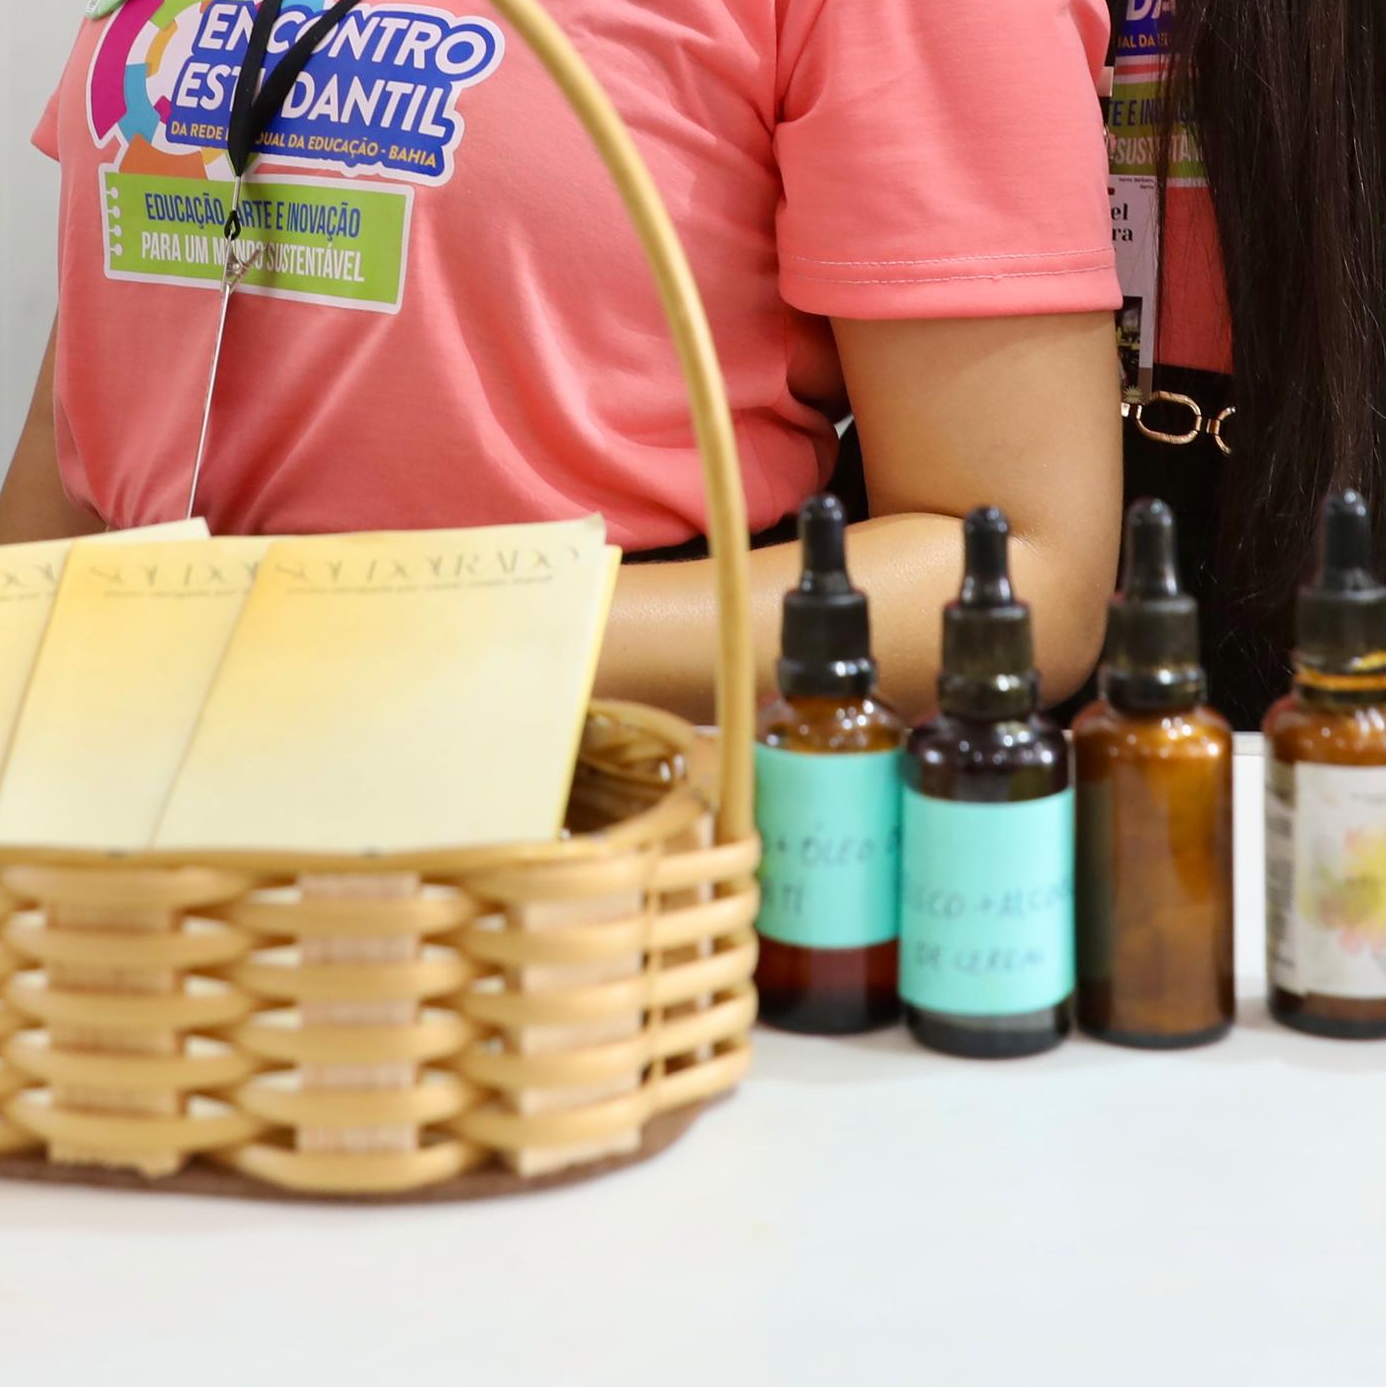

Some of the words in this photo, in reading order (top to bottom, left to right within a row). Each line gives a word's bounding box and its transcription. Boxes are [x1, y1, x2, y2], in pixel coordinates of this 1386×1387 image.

[175, 62, 447, 138] ESTDANTIL
[171, 120, 187, 135] DA
[190, 123, 223, 140] REDE
[288, 134, 304, 149] DA
[308, 136, 378, 159] EDUCAÇÃO
[388, 147, 436, 168] BAHIA
[237, 200, 273, 231] ARTE
[276, 202, 284, 231] E
[287, 201, 361, 241] INOVAÇÃO
[141, 231, 182, 263] PARA
[184, 234, 209, 264] UM
[213, 238, 264, 270] MNDO
[267, 242, 365, 282] SUSTENTÁVEL
